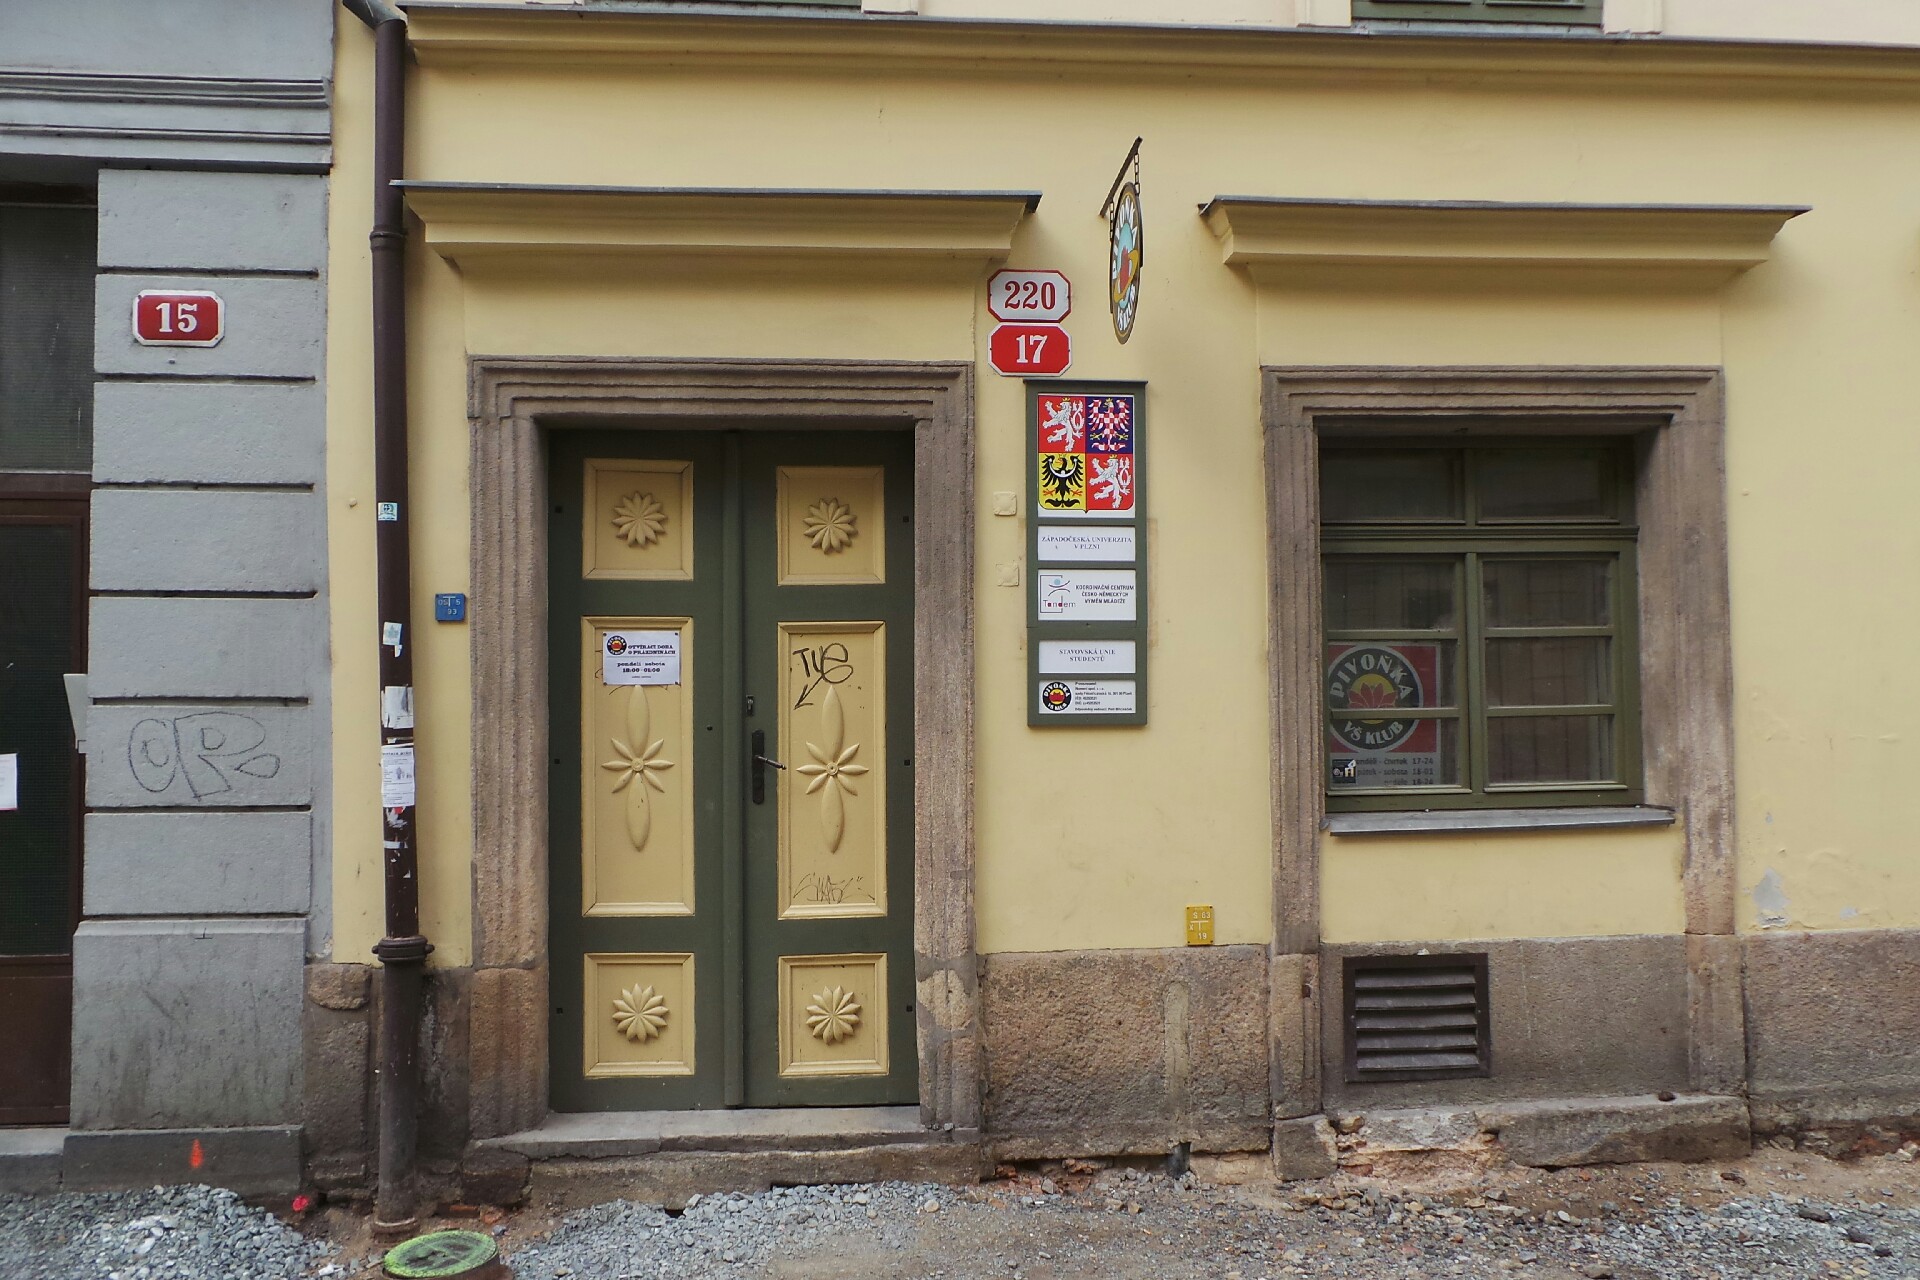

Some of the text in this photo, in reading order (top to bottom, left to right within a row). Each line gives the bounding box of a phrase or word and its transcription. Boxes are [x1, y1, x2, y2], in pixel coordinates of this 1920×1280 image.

[1004, 280, 1056, 310] 220
[155, 302, 198, 333] 15
[1016, 334, 1048, 364] 17
[1041, 535, 1090, 543] ZÁPADOČESKÁ
[1043, 598, 1076, 608] Tandem
[1059, 647, 1098, 655] STAVOVSKÁ
[1330, 653, 1414, 700] PIVOŇKA
[1343, 721, 1404, 745] VŠ KLUB
